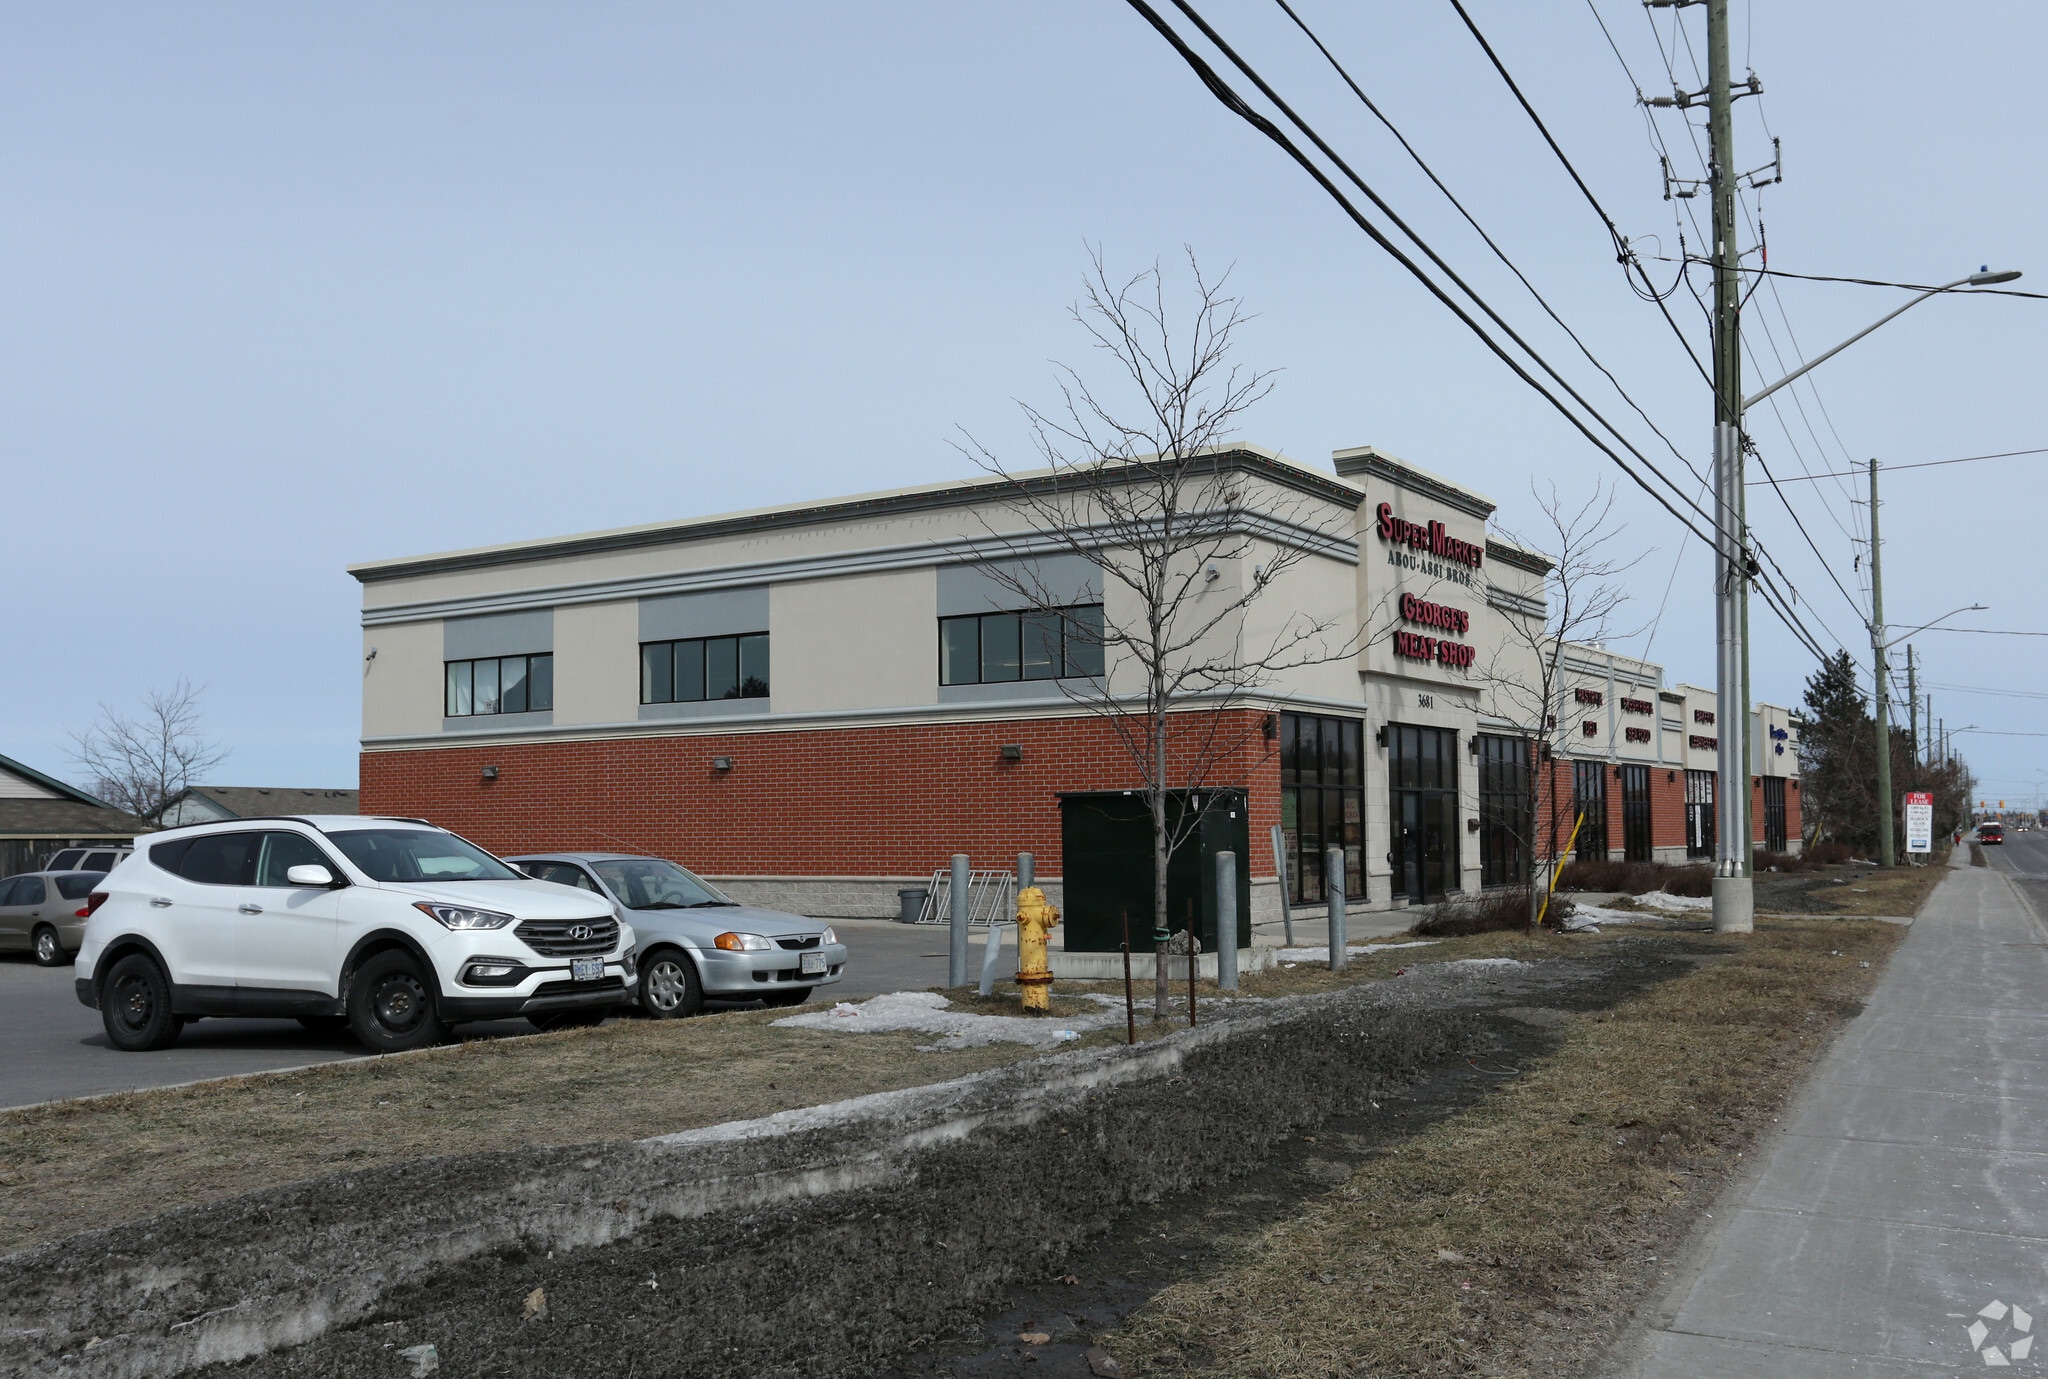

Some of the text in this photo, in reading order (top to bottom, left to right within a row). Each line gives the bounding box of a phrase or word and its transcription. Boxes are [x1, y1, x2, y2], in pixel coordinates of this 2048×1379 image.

[1399, 592, 1469, 633] GEORGE'S
[1393, 630, 1476, 667] MEAT SHOP
[1417, 693, 1434, 710] 3681
[1583, 721, 1597, 737] DELI
